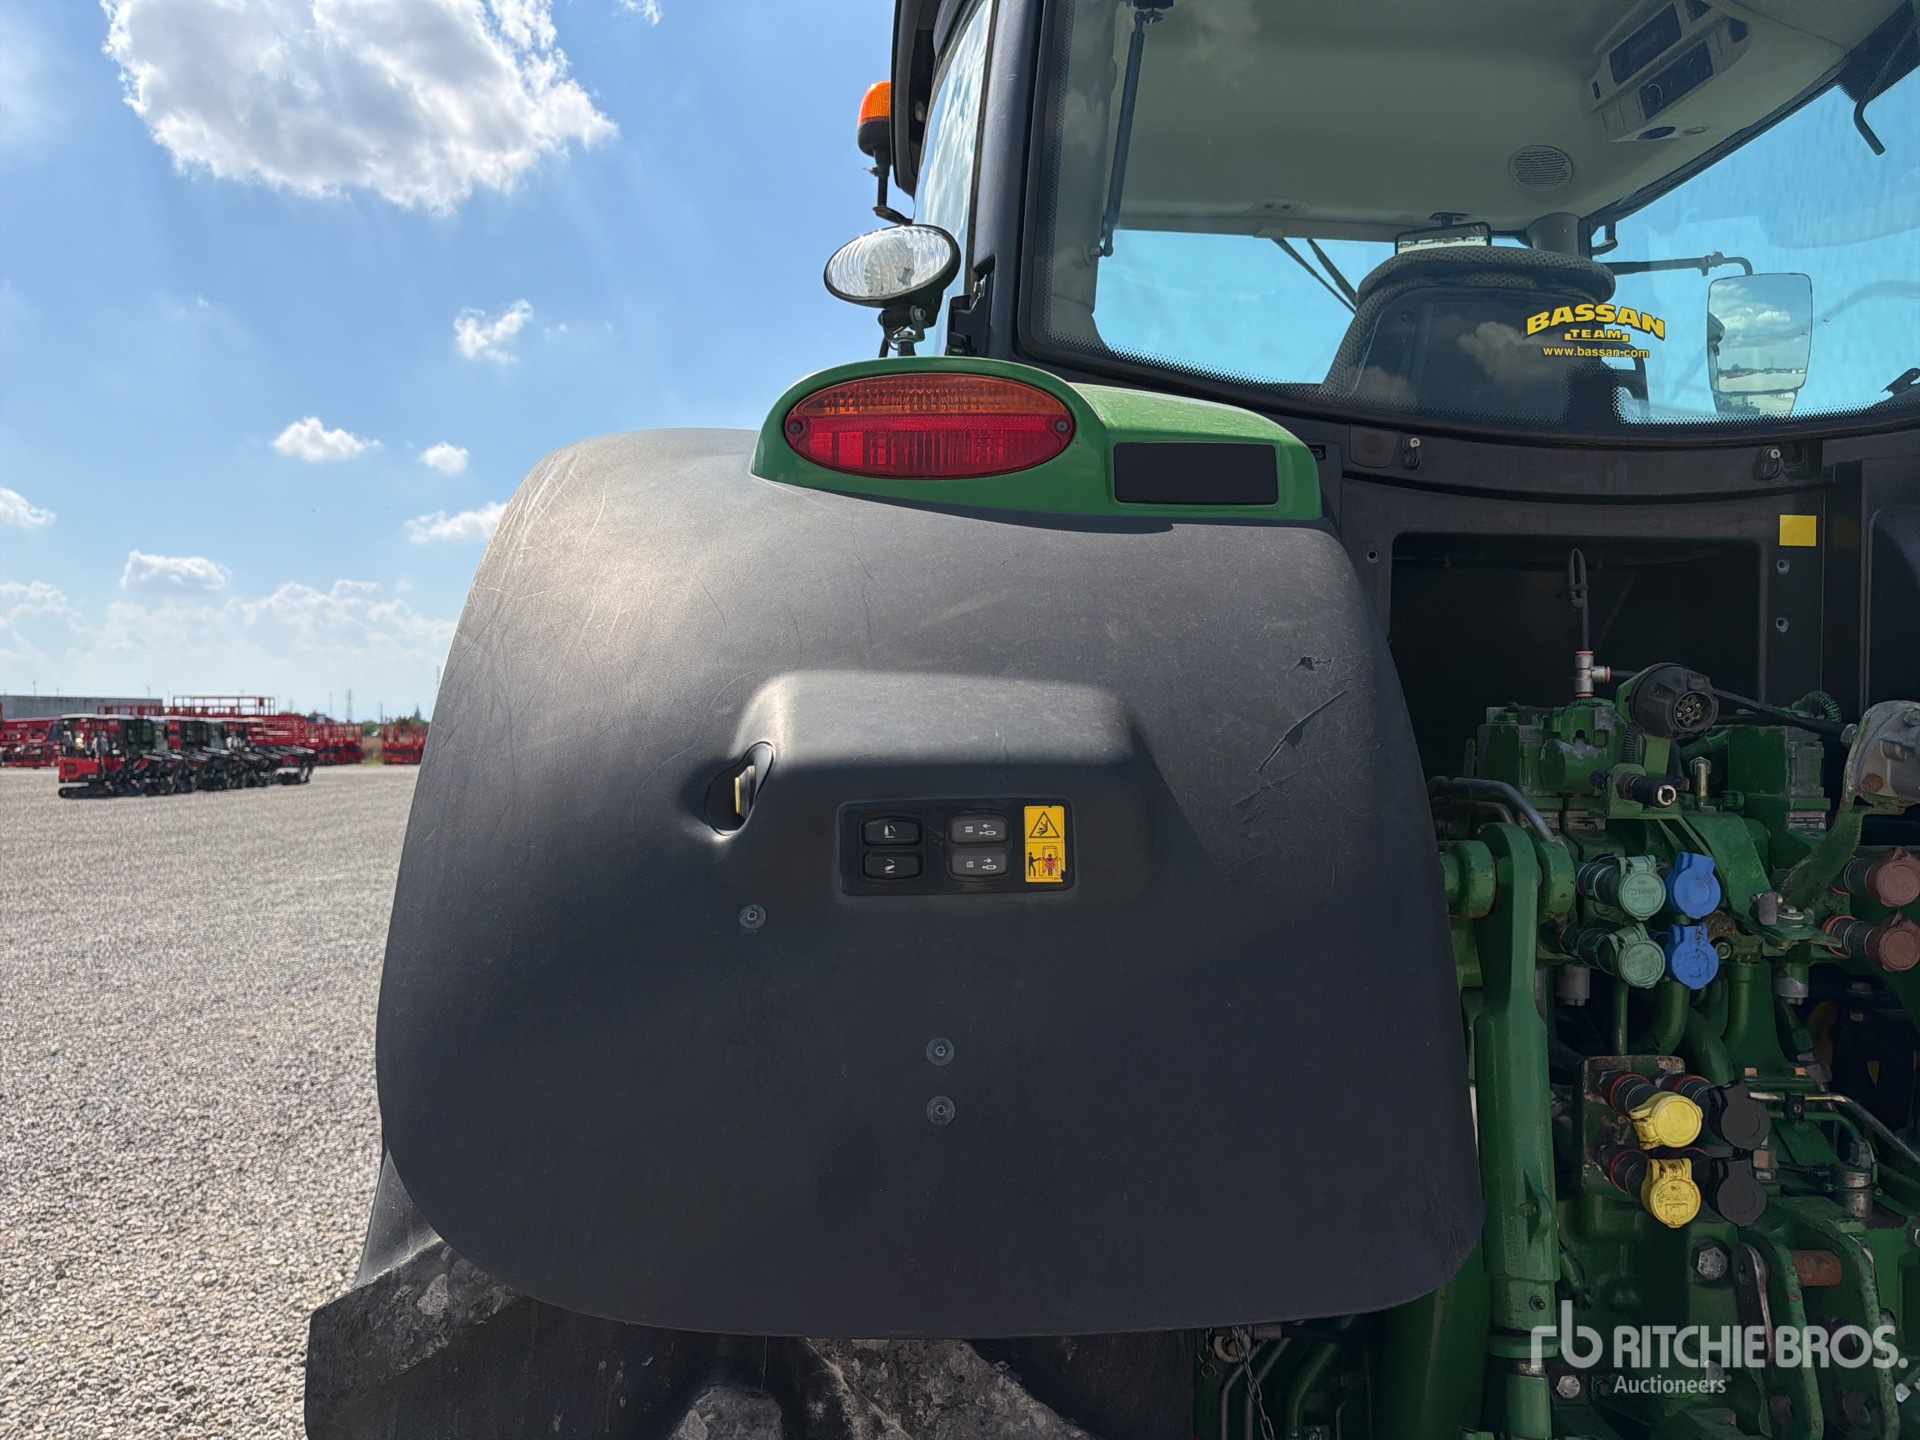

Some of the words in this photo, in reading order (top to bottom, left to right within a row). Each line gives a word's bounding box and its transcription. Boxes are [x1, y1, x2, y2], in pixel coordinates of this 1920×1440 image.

[1526, 303, 1666, 341] BASSAN
[1569, 329, 1622, 339] TEAM
[1542, 346, 1650, 358] www.bassan.com
